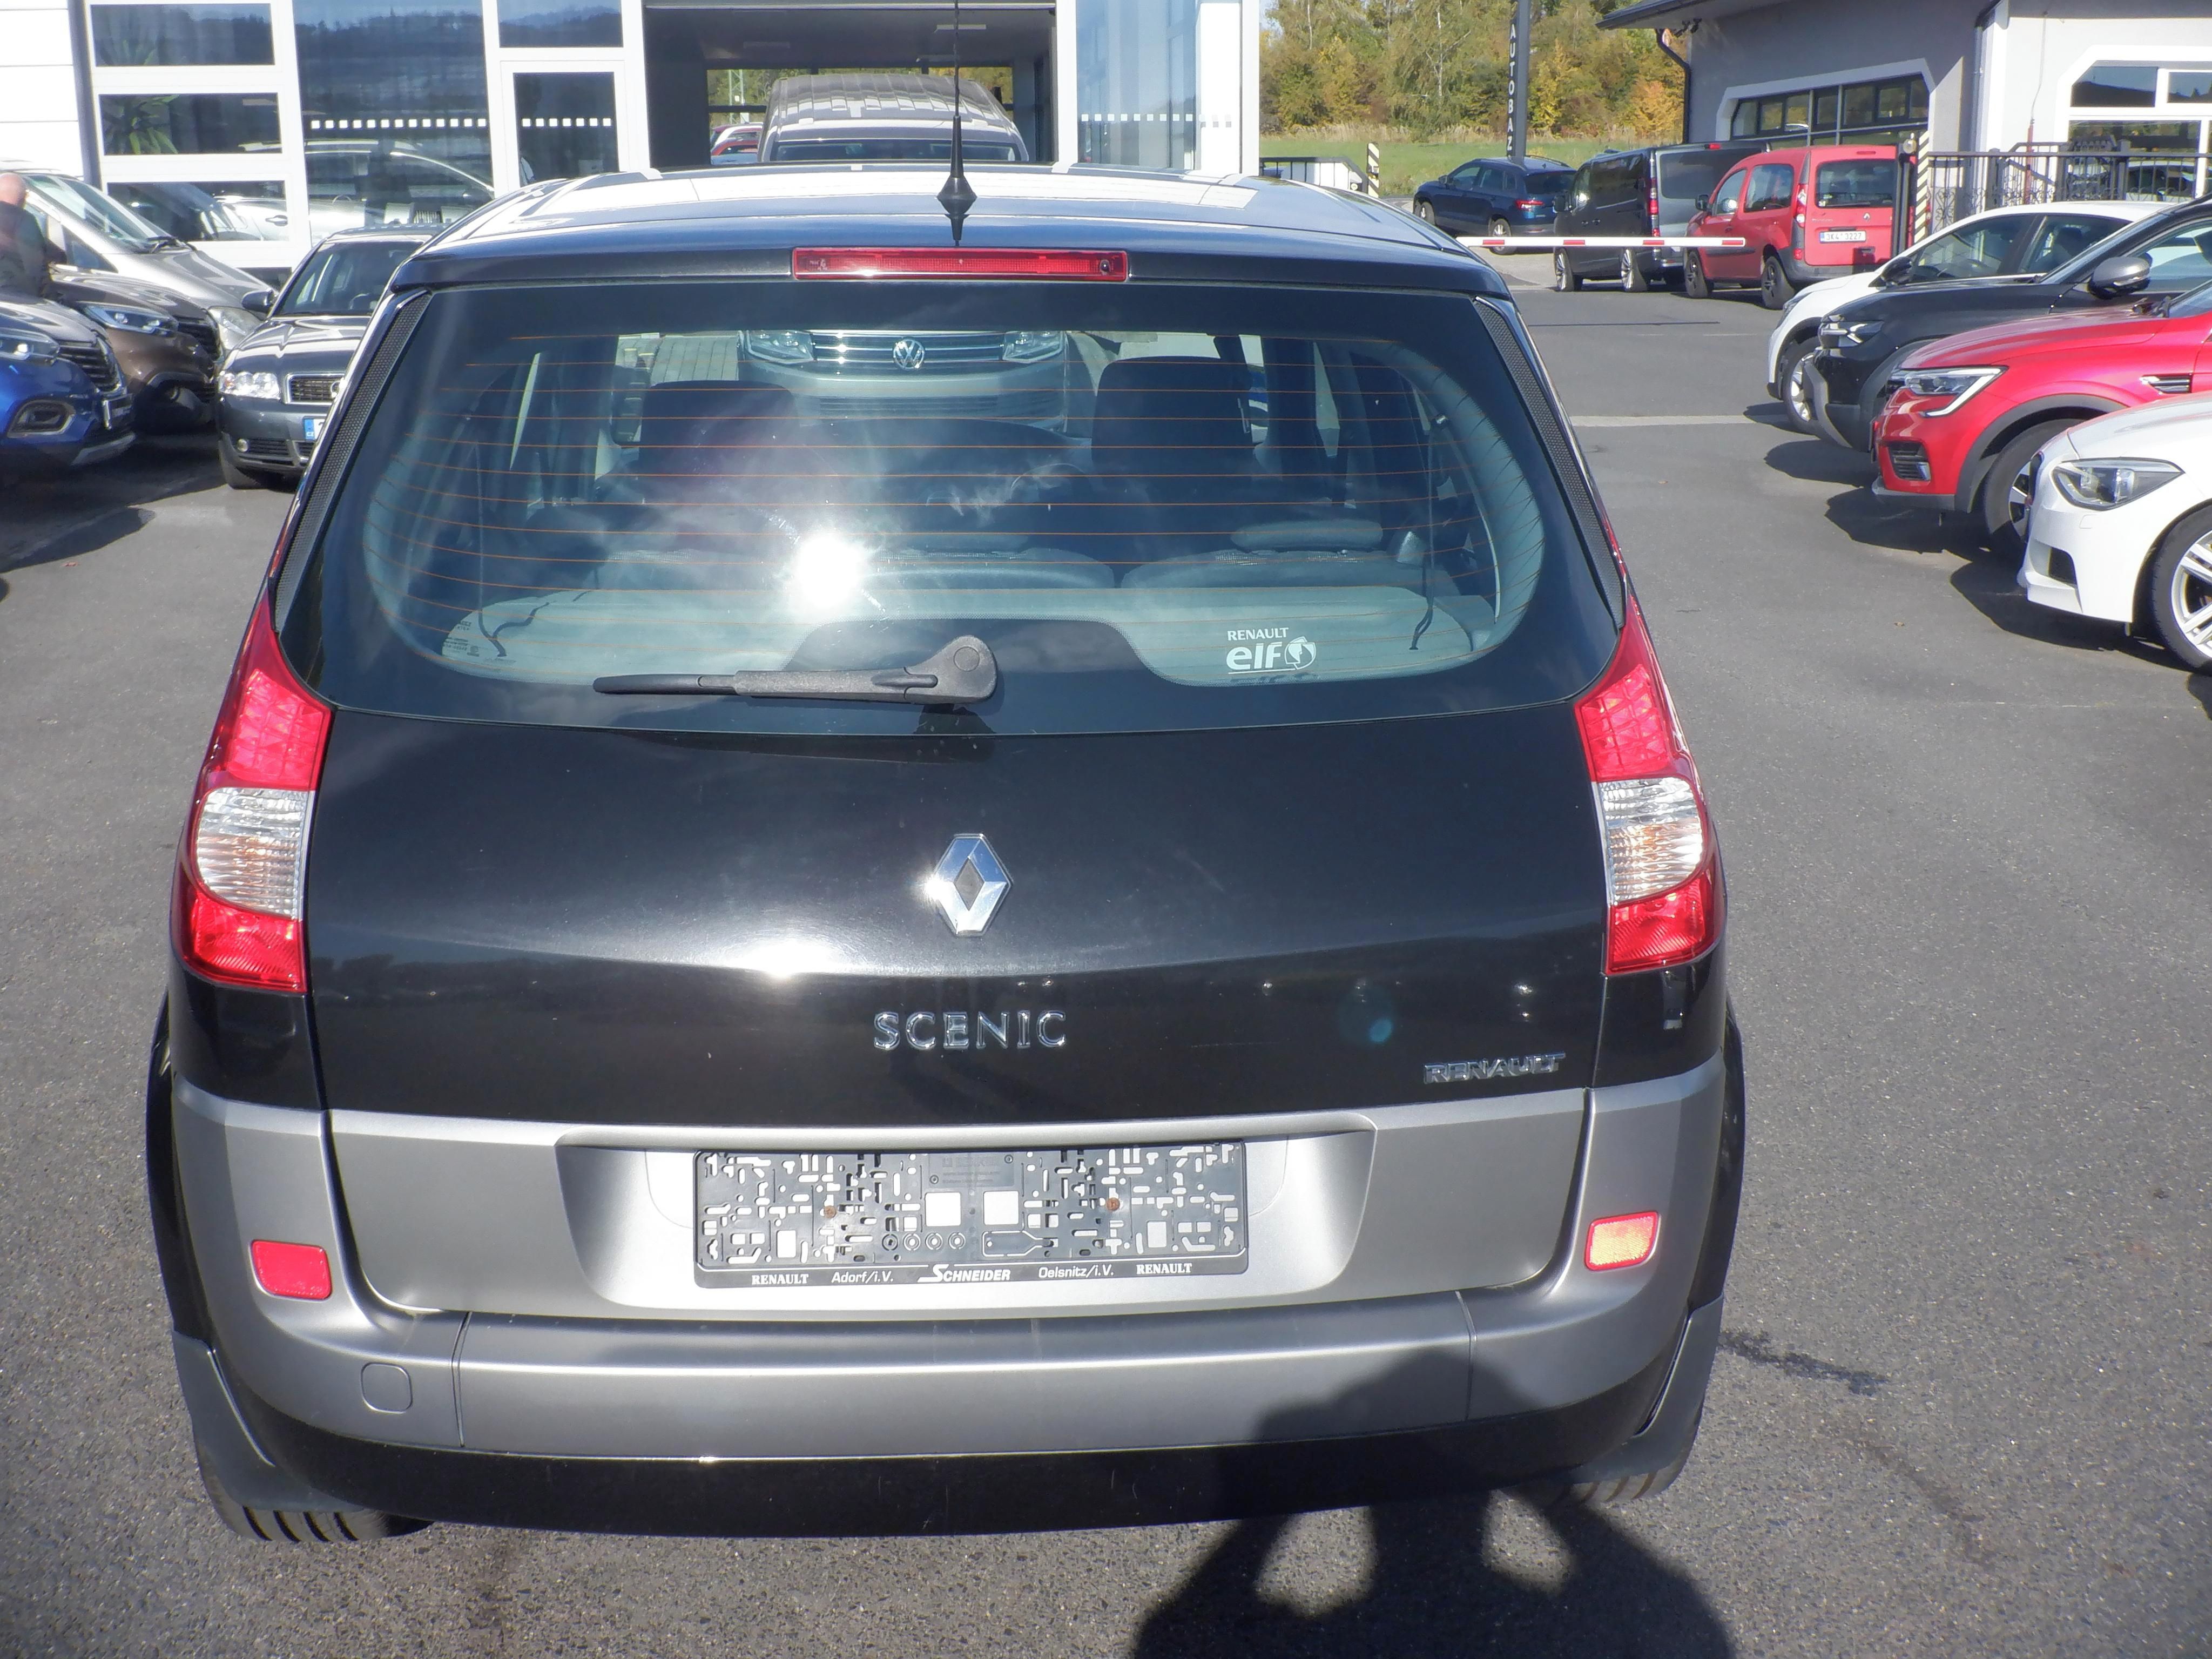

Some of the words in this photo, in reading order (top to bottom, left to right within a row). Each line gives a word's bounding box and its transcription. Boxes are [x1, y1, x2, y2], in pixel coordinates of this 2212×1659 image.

[1227, 627, 1289, 641] RENAULT
[1226, 642, 1283, 670] elf
[874, 1010, 1066, 1050] SCENIC
[1424, 1051, 1566, 1084] RENAULT
[751, 1273, 809, 1285] RENAULT
[831, 1271, 894, 1284] Adorf/i.V.
[917, 1264, 1011, 1283] SCHNEIDER
[1038, 1264, 1114, 1278] Oelsnitz/i.V.
[1136, 1263, 1192, 1275] RENAULT
